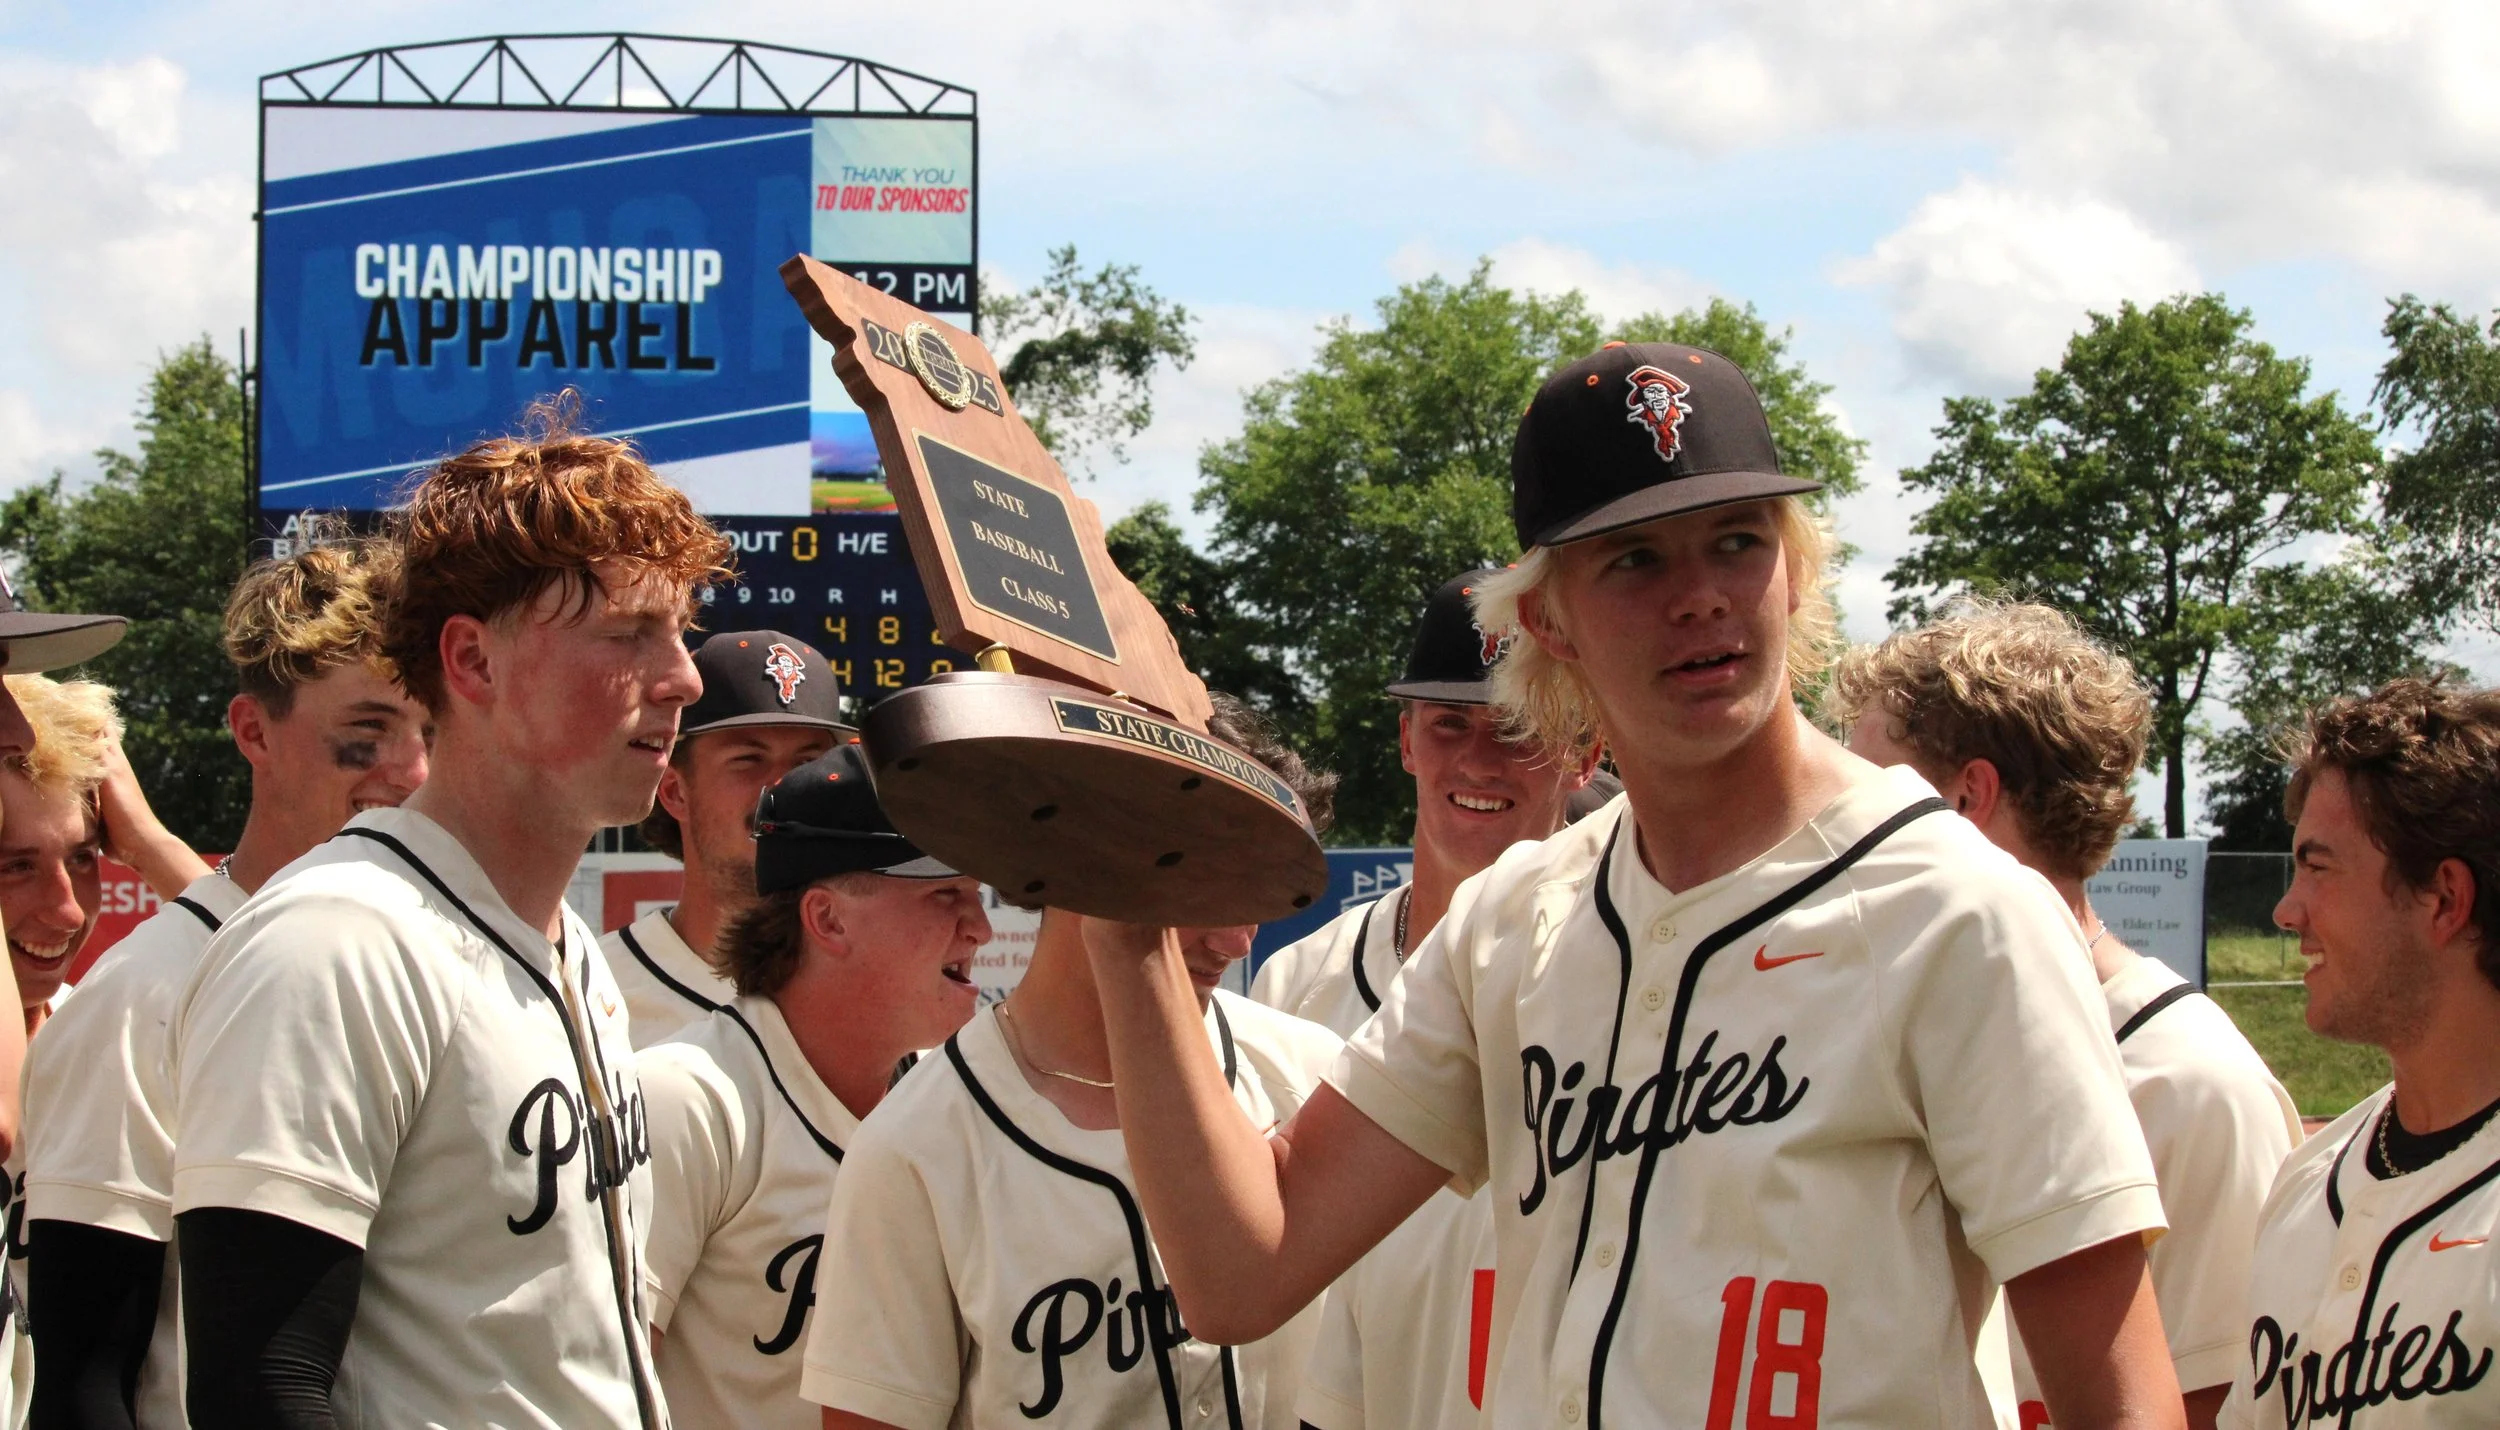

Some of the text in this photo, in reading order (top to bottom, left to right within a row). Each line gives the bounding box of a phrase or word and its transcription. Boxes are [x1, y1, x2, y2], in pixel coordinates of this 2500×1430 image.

[842, 165, 955, 184] THANK YOU
[815, 184, 969, 214] TO OUR SPONSORS
[355, 243, 722, 303] CHAMPIONSHIP
[913, 272, 966, 305] PM
[358, 290, 719, 373] APPAREL
[972, 479, 1030, 519] STATE
[724, 526, 888, 562] OUT 0 H/E
[970, 520, 1065, 576] BASEBALL
[737, 586, 752, 604] 9
[767, 587, 796, 604] 10
[828, 588, 844, 604] R
[880, 589, 898, 605] H
[1001, 576, 1070, 620] CLASS 5
[825, 616, 846, 644] 4
[878, 615, 900, 645] 8
[873, 658, 906, 688] 12
[1095, 710, 1279, 798] STATE CHAMPIONS
[2086, 882, 2162, 898] Law Group
[1519, 1030, 1810, 1217] Pirates
[1705, 1276, 1829, 1430] 18
[2250, 1302, 2494, 1430] Pirates
